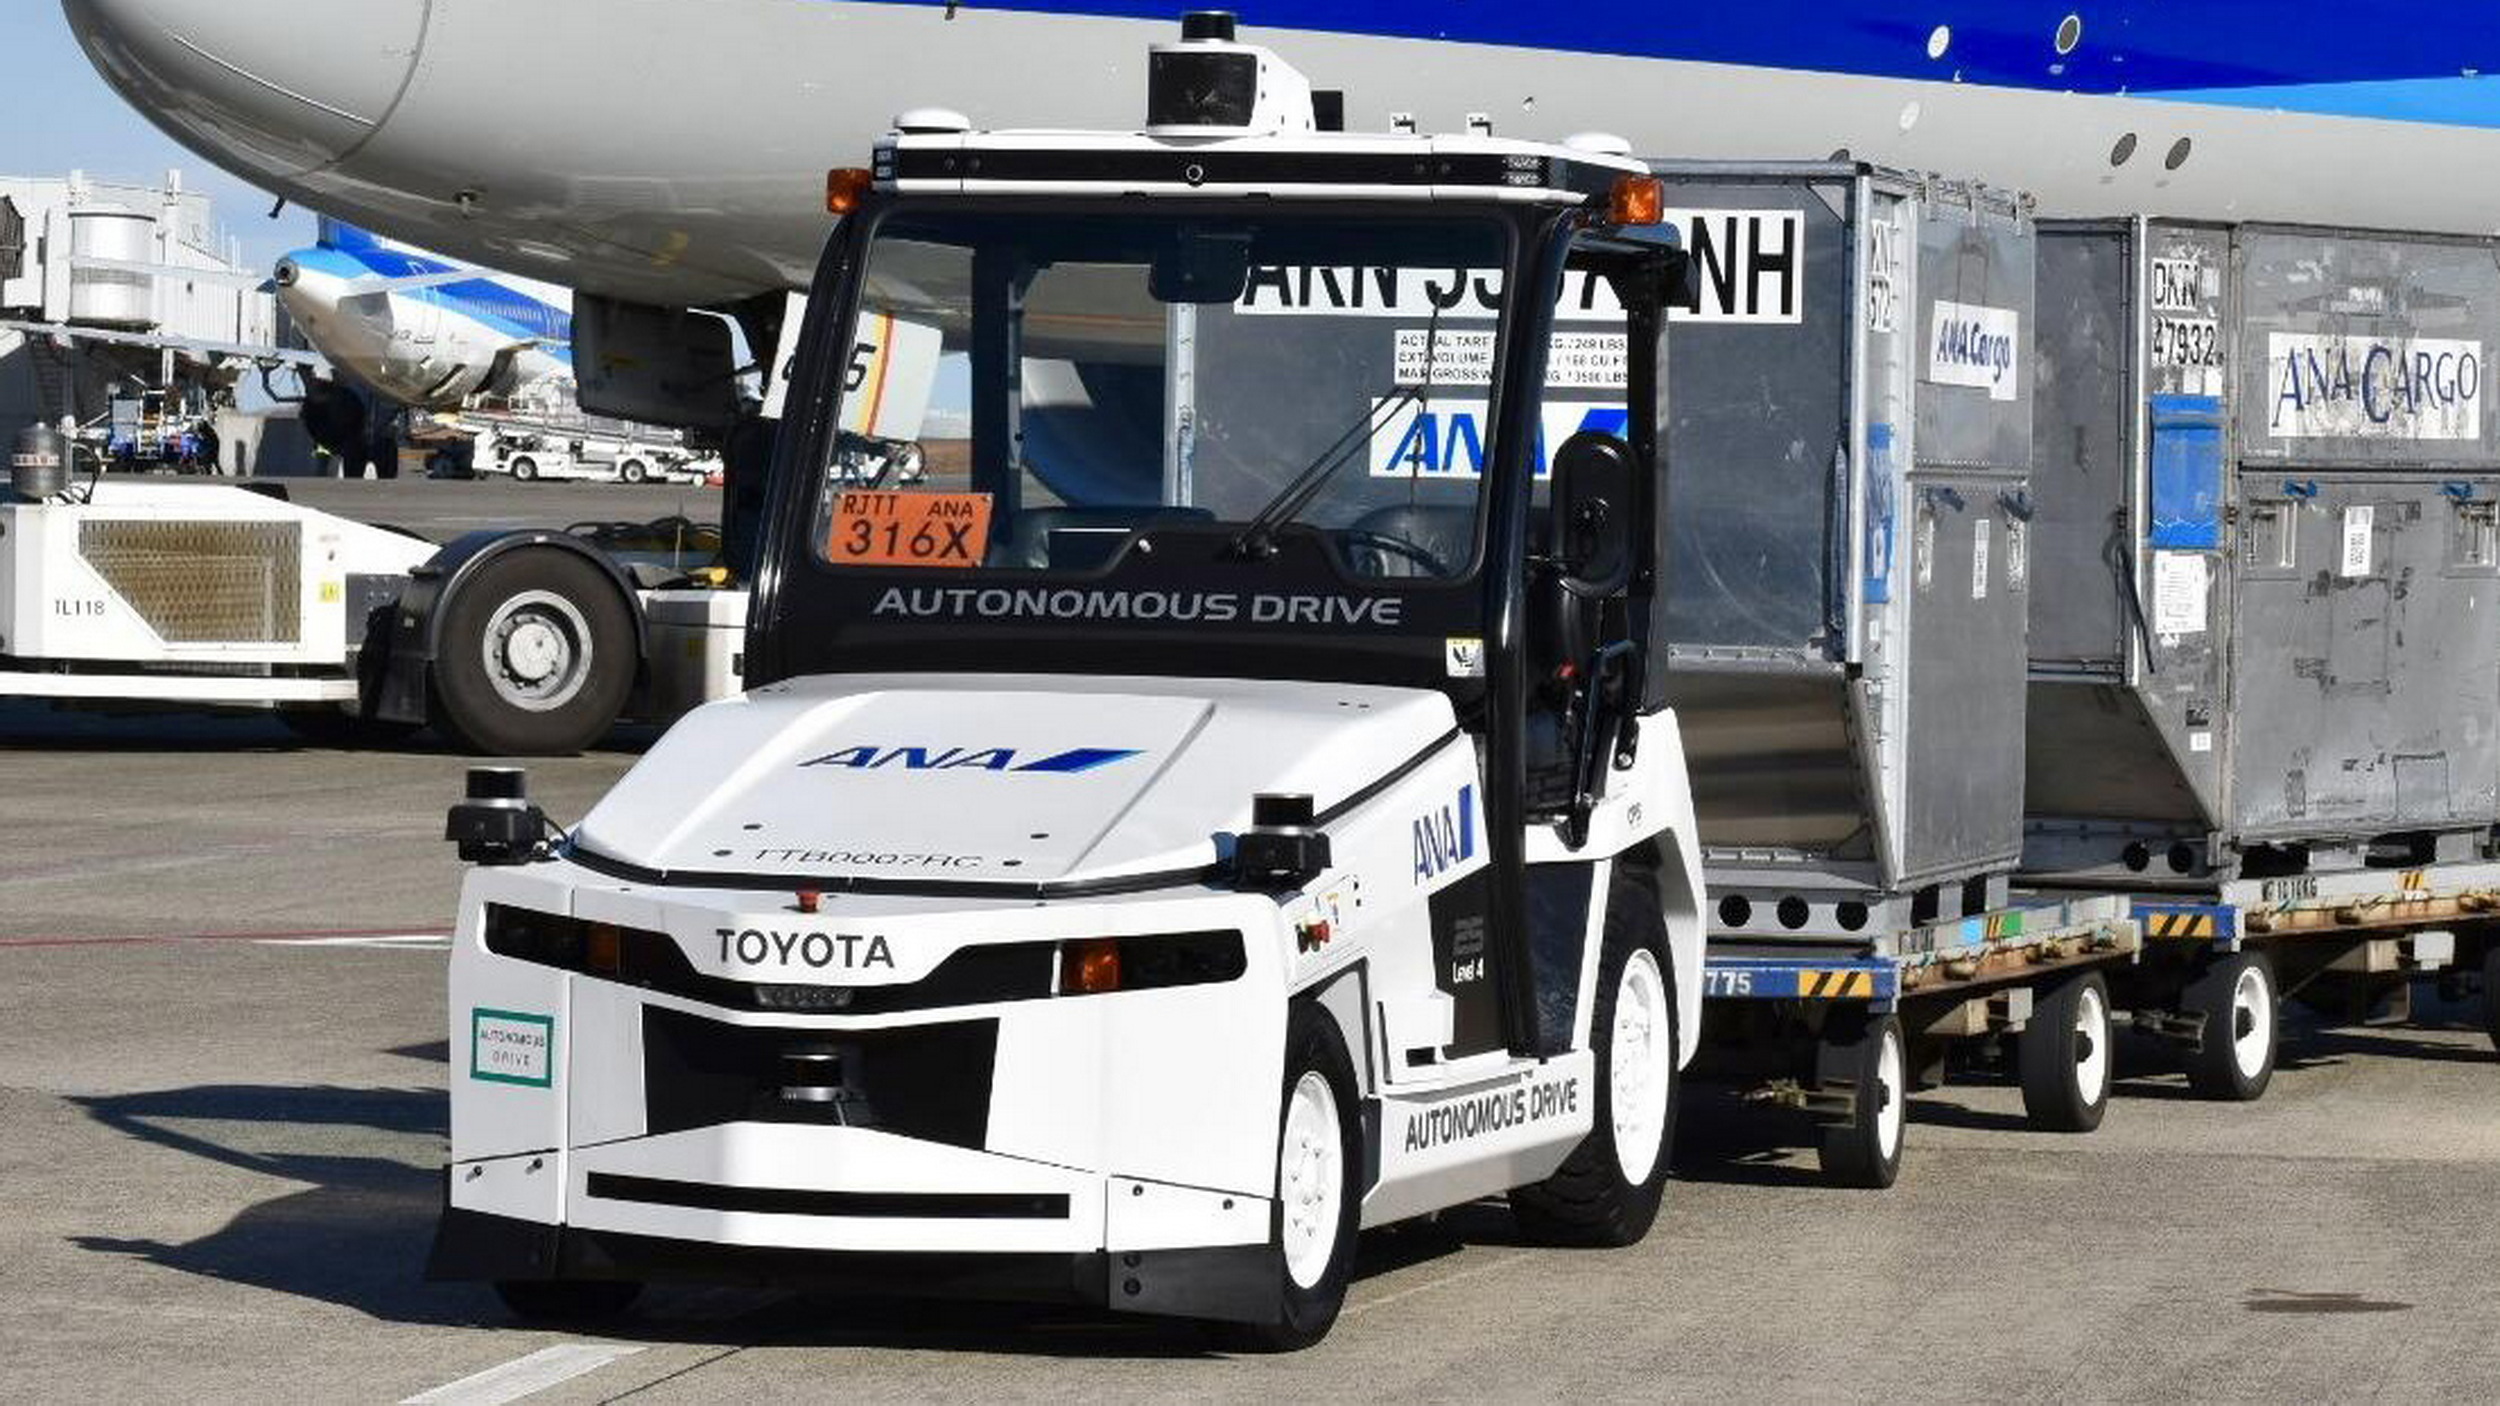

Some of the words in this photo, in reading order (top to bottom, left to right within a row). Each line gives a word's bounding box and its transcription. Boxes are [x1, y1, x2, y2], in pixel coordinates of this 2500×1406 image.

[1936, 319, 1968, 364] ANA
[1970, 322, 2010, 383] Cargo
[2271, 346, 2353, 428] ANA
[2361, 342, 2478, 424] CARGO
[842, 494, 899, 516] RJTT
[927, 501, 973, 517] ANA
[846, 519, 972, 559] 316X
[873, 587, 1238, 621] AUTONOMOUS
[1251, 595, 1402, 625] DRIVE
[796, 747, 1017, 770] ANA
[1413, 804, 1459, 886] ANA
[715, 928, 895, 968] TOYOTA
[1405, 1089, 1526, 1153] AUTONOMOUS
[1530, 1077, 1577, 1121] DRIVE
